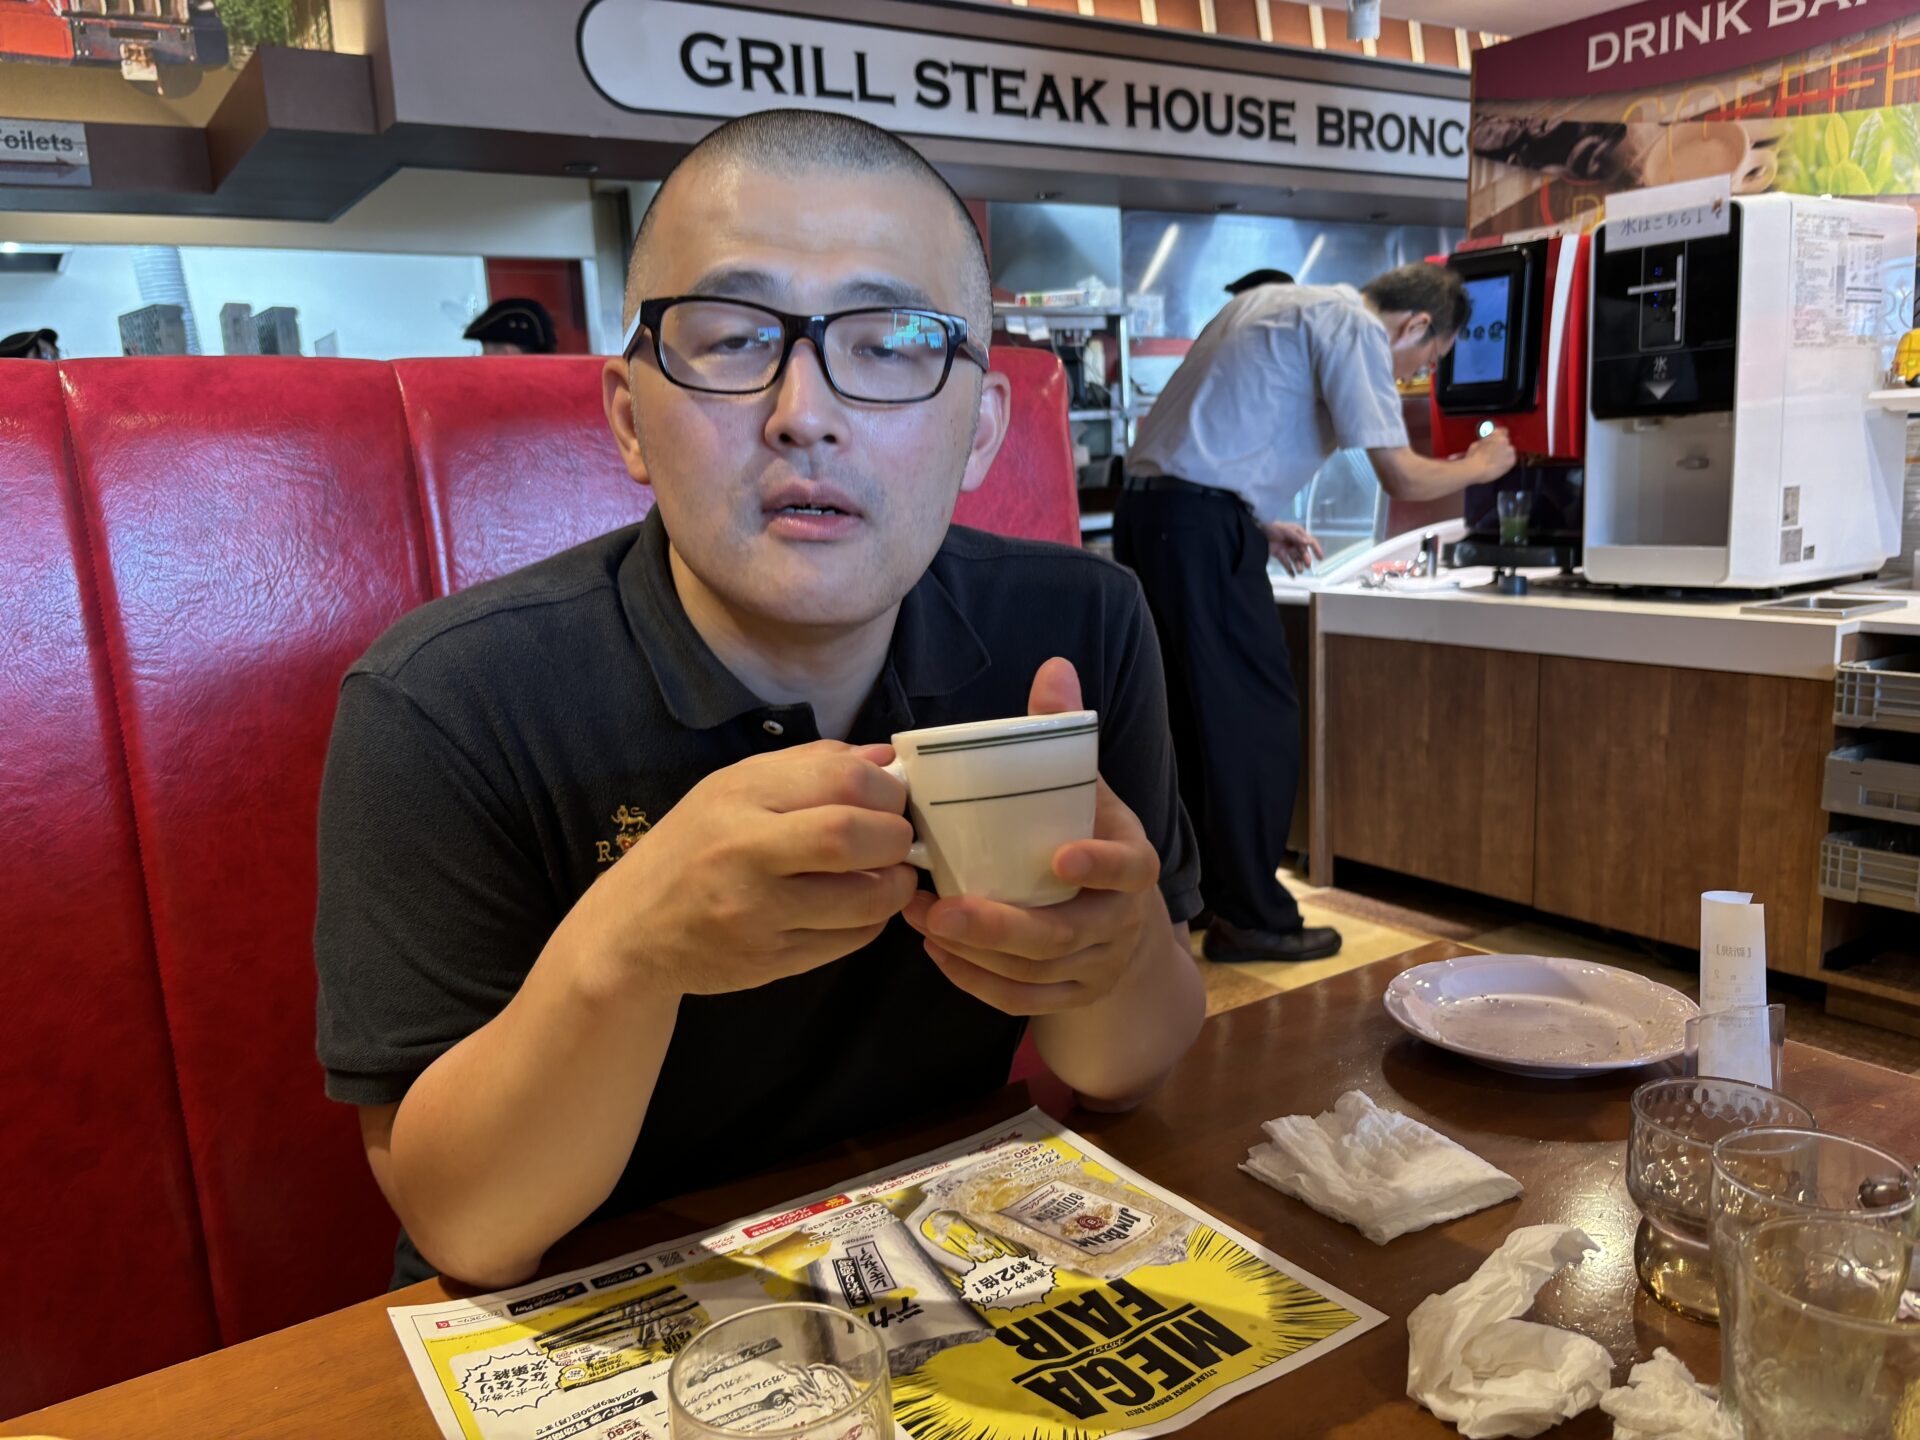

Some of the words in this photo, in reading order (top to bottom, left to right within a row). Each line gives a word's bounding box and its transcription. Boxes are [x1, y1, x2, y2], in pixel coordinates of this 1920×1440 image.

[1587, 0, 1752, 73] DRINK
[680, 31, 896, 107] GRILL
[914, 59, 1108, 127] STEAK
[1125, 83, 1297, 145] HOUSE
[1317, 106, 1468, 158] BRONC
[0, 129, 74, 152] oilets
[1118, 1207, 1142, 1232] JIM
[1071, 1232, 1130, 1248] BEAM
[860, 1247, 888, 1290] レモンサワー
[972, 1260, 1033, 1294] 約2倍!
[982, 1268, 1049, 1304] 通常サイズの
[995, 1277, 1167, 1361] FAIR
[476, 1359, 549, 1383] 次第終了
[1024, 1308, 1253, 1420] MEGA
[478, 1381, 549, 1404] クーポン券が
[479, 1371, 548, 1395] なくなり
[535, 1387, 640, 1436] 2024年9月30日(月)まで
